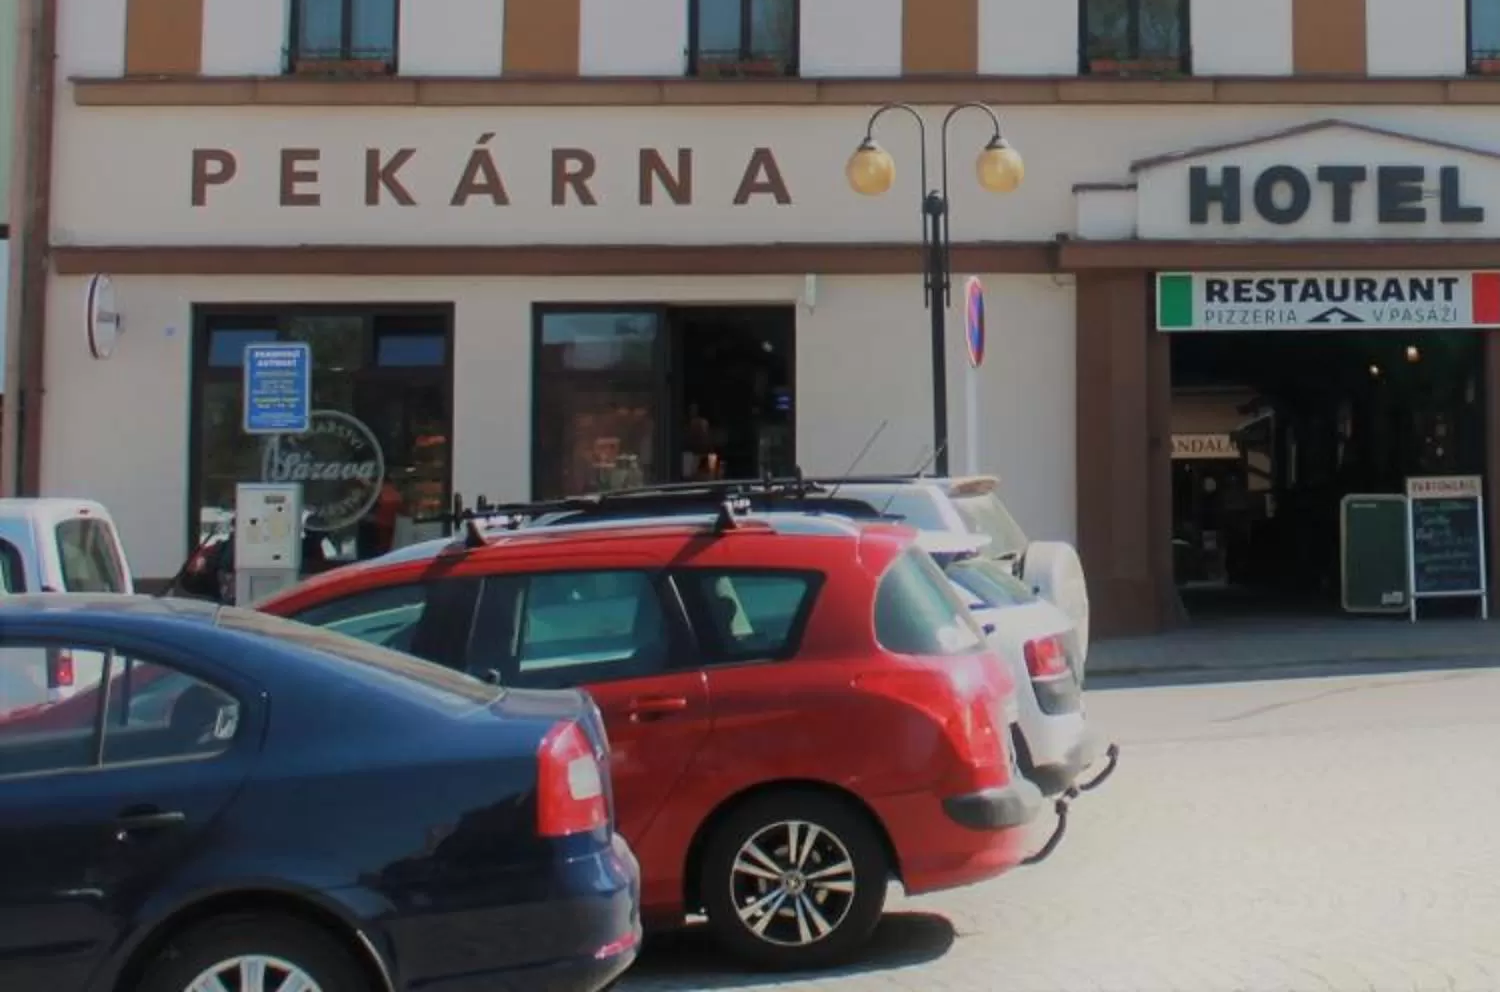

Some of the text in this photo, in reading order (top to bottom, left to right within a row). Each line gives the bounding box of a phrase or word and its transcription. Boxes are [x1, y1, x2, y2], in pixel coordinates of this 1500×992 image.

[191, 132, 793, 207] PEKÁRNA
[1188, 164, 1485, 225] HOTEL
[1204, 276, 1460, 304] RESTAURANT
[1204, 308, 1298, 325] PIZZERIA
